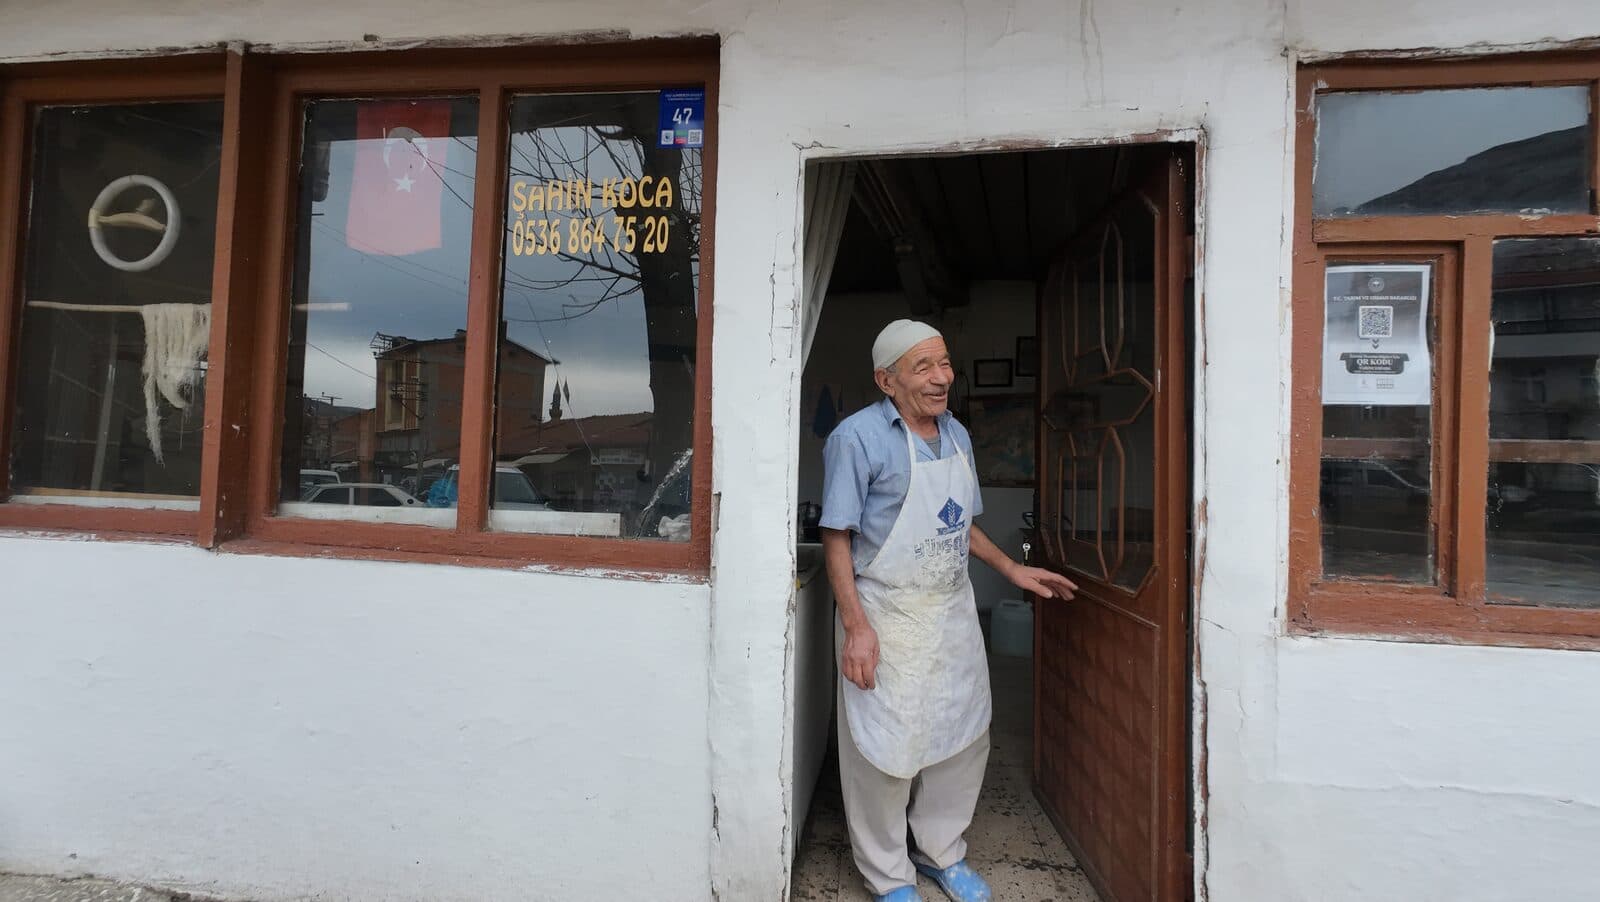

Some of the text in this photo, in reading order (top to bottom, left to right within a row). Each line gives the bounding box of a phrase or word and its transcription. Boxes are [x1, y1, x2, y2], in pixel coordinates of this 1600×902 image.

[672, 108, 692, 125] 47
[512, 174, 673, 219] ŞAHİN KOCA
[512, 215, 669, 256] 0536 864 75 20
[1356, 358, 1393, 366] QR KODU
